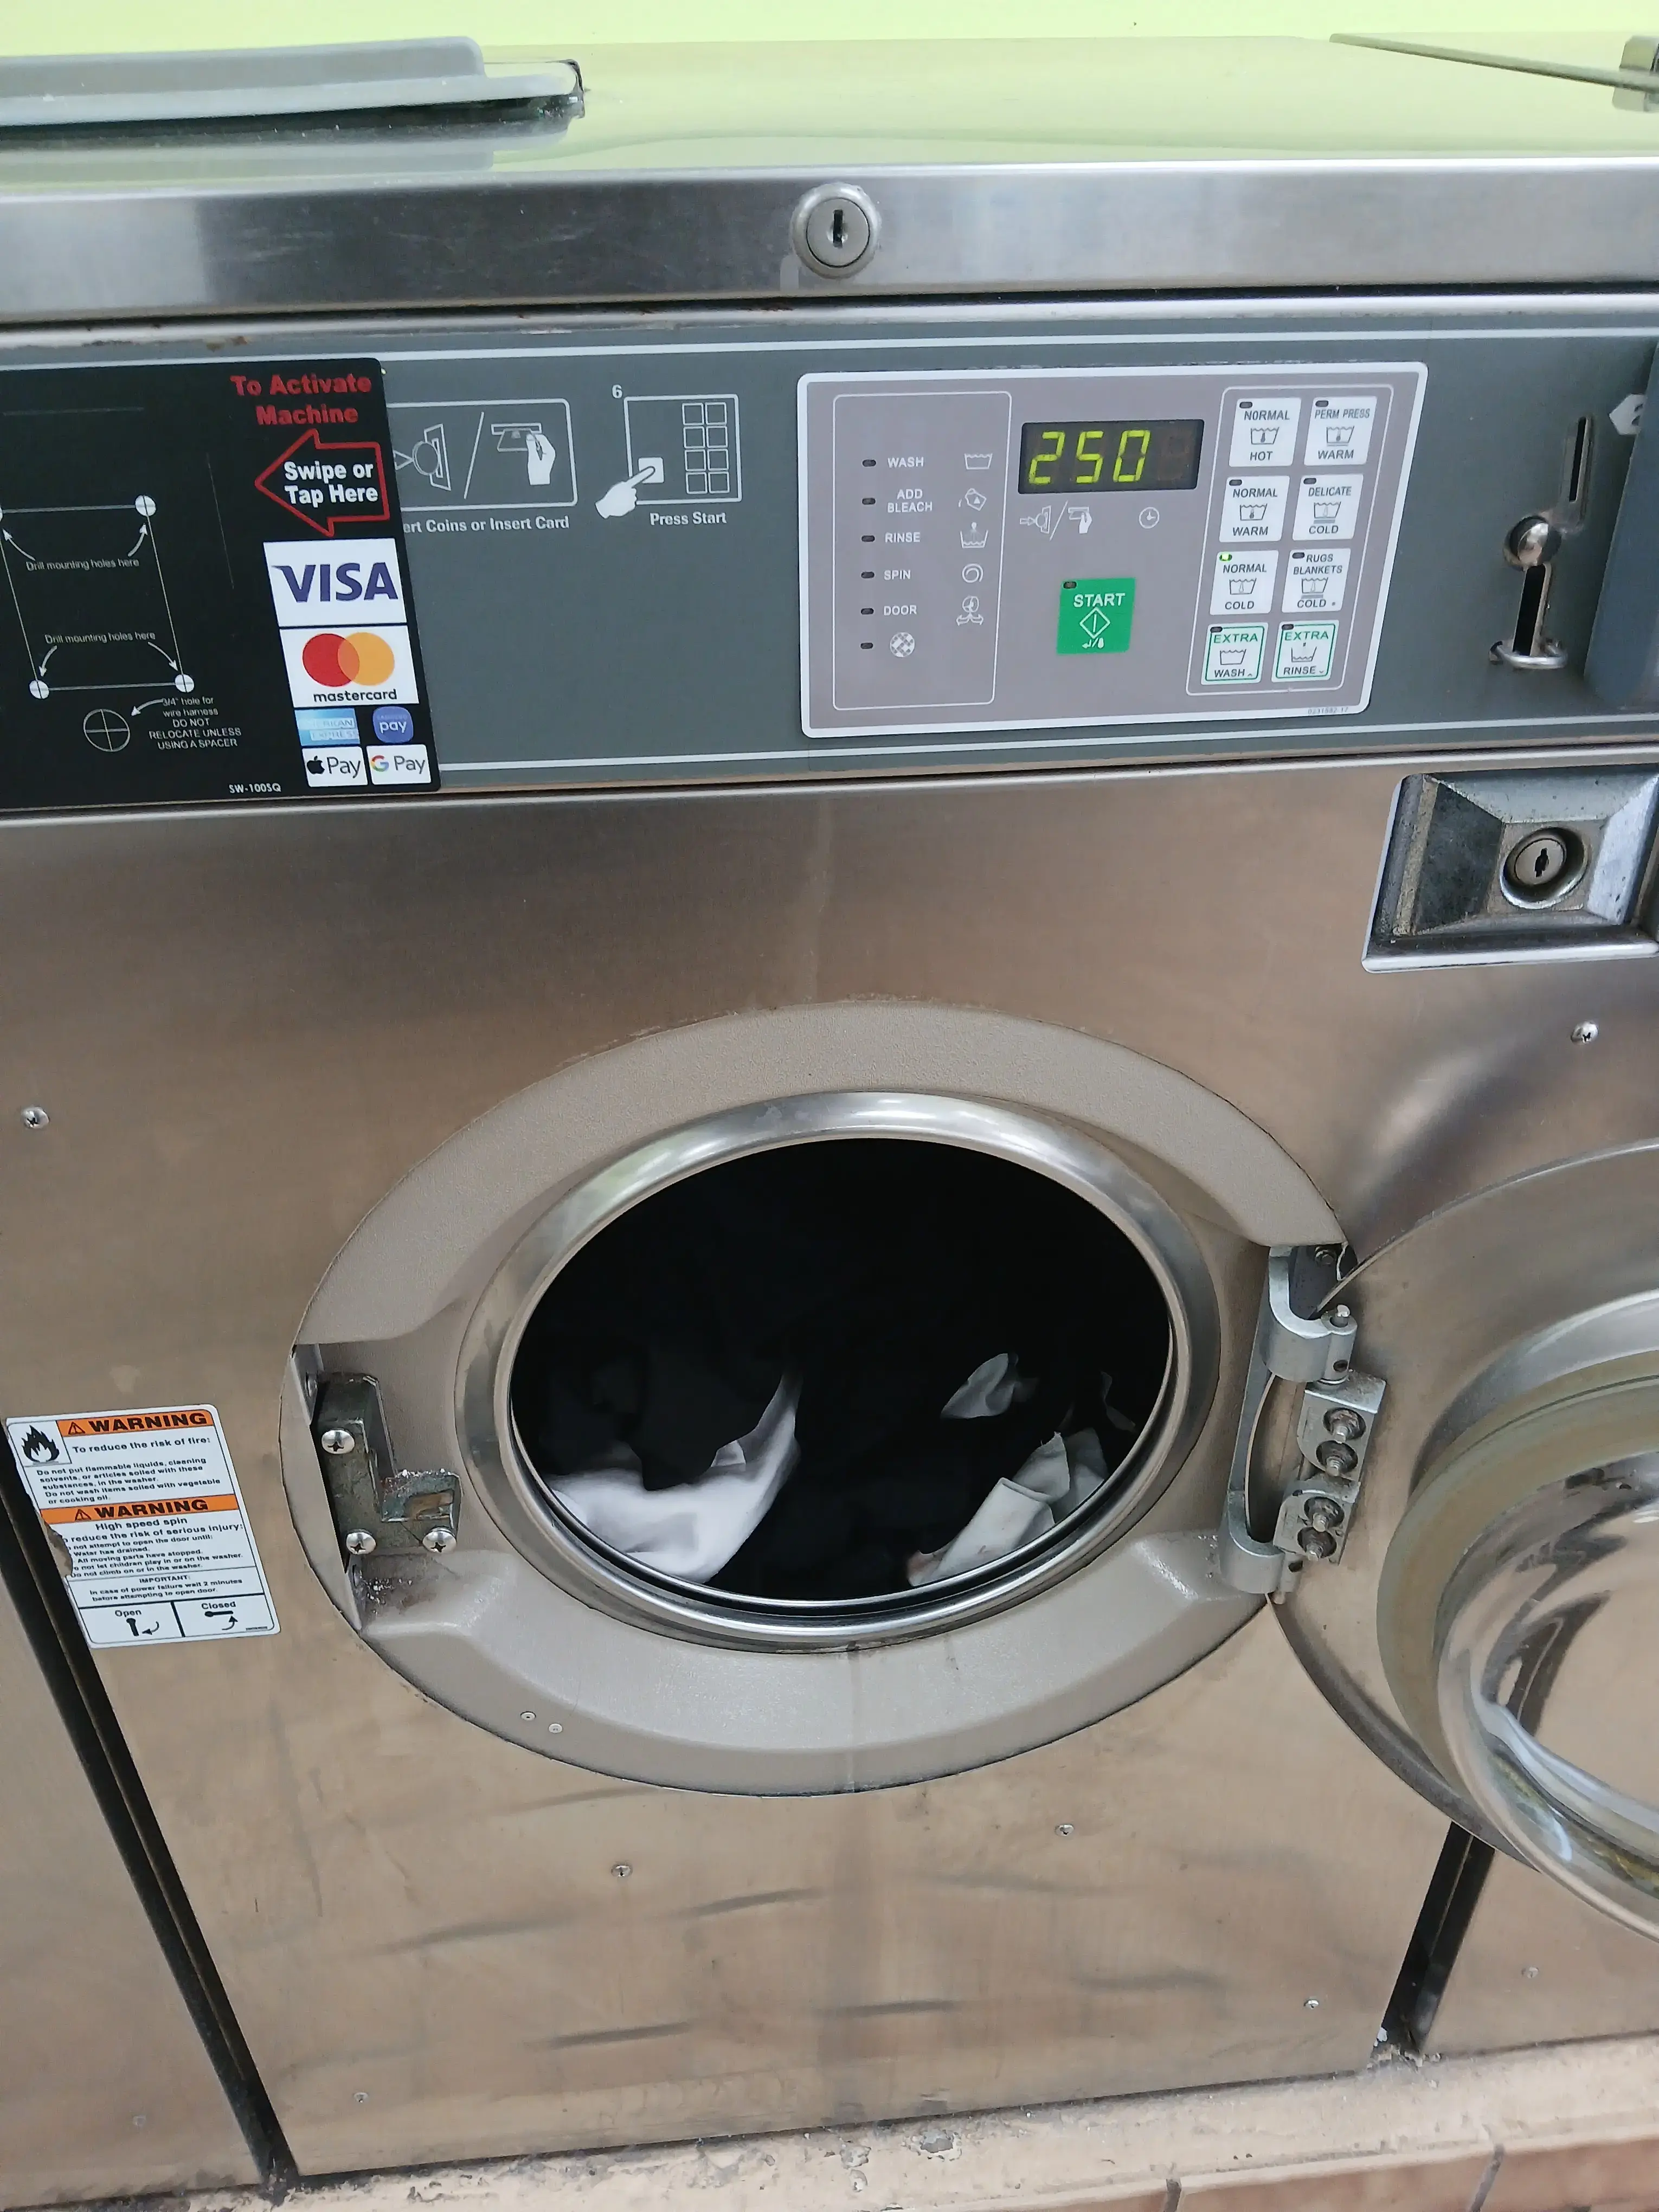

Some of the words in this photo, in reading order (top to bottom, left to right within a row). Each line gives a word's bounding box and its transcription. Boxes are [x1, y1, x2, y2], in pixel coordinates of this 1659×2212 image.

[230, 375, 262, 396] To
[269, 372, 372, 395] Activate
[612, 384, 623, 399] 6
[255, 403, 358, 425] Machine
[1243, 409, 1290, 421] NORMAL
[1314, 409, 1340, 419] PERM
[1342, 408, 1371, 419] PRESS
[1028, 429, 1150, 484] 250
[1249, 451, 1273, 461] HOT
[1317, 449, 1354, 460] WARM
[887, 456, 924, 468] WASH
[284, 460, 347, 484] Swipe
[353, 463, 374, 479] or
[284, 485, 324, 508] Tap
[329, 484, 378, 503] Here
[896, 488, 923, 500] ADD
[1232, 487, 1278, 498] NORMAL
[1308, 486, 1352, 497] DELICATE
[886, 501, 933, 513] BLEACH
[403, 521, 422, 533] ert
[426, 519, 467, 532] Coins
[470, 520, 487, 531] or
[490, 517, 532, 530] Insert
[535, 515, 569, 529] Card
[650, 512, 689, 526] Press
[692, 511, 727, 525] Start
[1232, 526, 1269, 536] WARM
[1308, 524, 1339, 535] COLD
[884, 531, 921, 543] RINSE
[1306, 553, 1334, 563] RUGS
[25, 561, 45, 571] Drill
[47, 560, 89, 570] mounting
[91, 559, 116, 568] holes
[118, 558, 139, 567] here
[1222, 563, 1267, 574] NORMAL
[1293, 564, 1343, 575] BLANKETS
[883, 569, 911, 581] SPIN
[271, 562, 398, 603] VISA
[1073, 592, 1126, 607] START
[1224, 600, 1255, 610] COLD
[1296, 599, 1327, 609] COLD
[883, 605, 917, 616] DOOR
[44, 634, 63, 644] Drill
[65, 633, 107, 644] mounting
[108, 632, 133, 641] holes
[135, 631, 156, 640] here
[1213, 632, 1258, 644] EXTRA
[1284, 631, 1329, 642] EXTRA
[1213, 667, 1245, 678] WASH
[1283, 665, 1317, 676] RINSE
[181, 697, 200, 705] hole
[202, 696, 214, 704] for
[313, 689, 397, 703] mastercard
[163, 709, 181, 718] wire
[183, 708, 218, 717] harness
[172, 718, 188, 728] DO
[190, 717, 210, 728] NOT
[379, 721, 407, 734] pay
[149, 729, 201, 740] RELOCATE
[203, 727, 242, 737] UNLESS
[157, 741, 189, 750] USING
[190, 740, 197, 748] A
[199, 738, 238, 749] SPACER
[326, 756, 361, 779] Pay
[370, 755, 389, 772] G
[394, 755, 426, 775] Pay
[88, 1412, 207, 1432] WARNING
[89, 1444, 127, 1452] reduce
[150, 1439, 172, 1448] risk
[94, 1499, 208, 1519] WARNING
[95, 1522, 123, 1531] High
[125, 1519, 160, 1529] speed
[163, 1517, 188, 1527] spin
[71, 1534, 108, 1542] reduce
[166, 1526, 206, 1535] serious
[201, 1601, 236, 1610] Closed
[114, 1609, 143, 1618] Open
